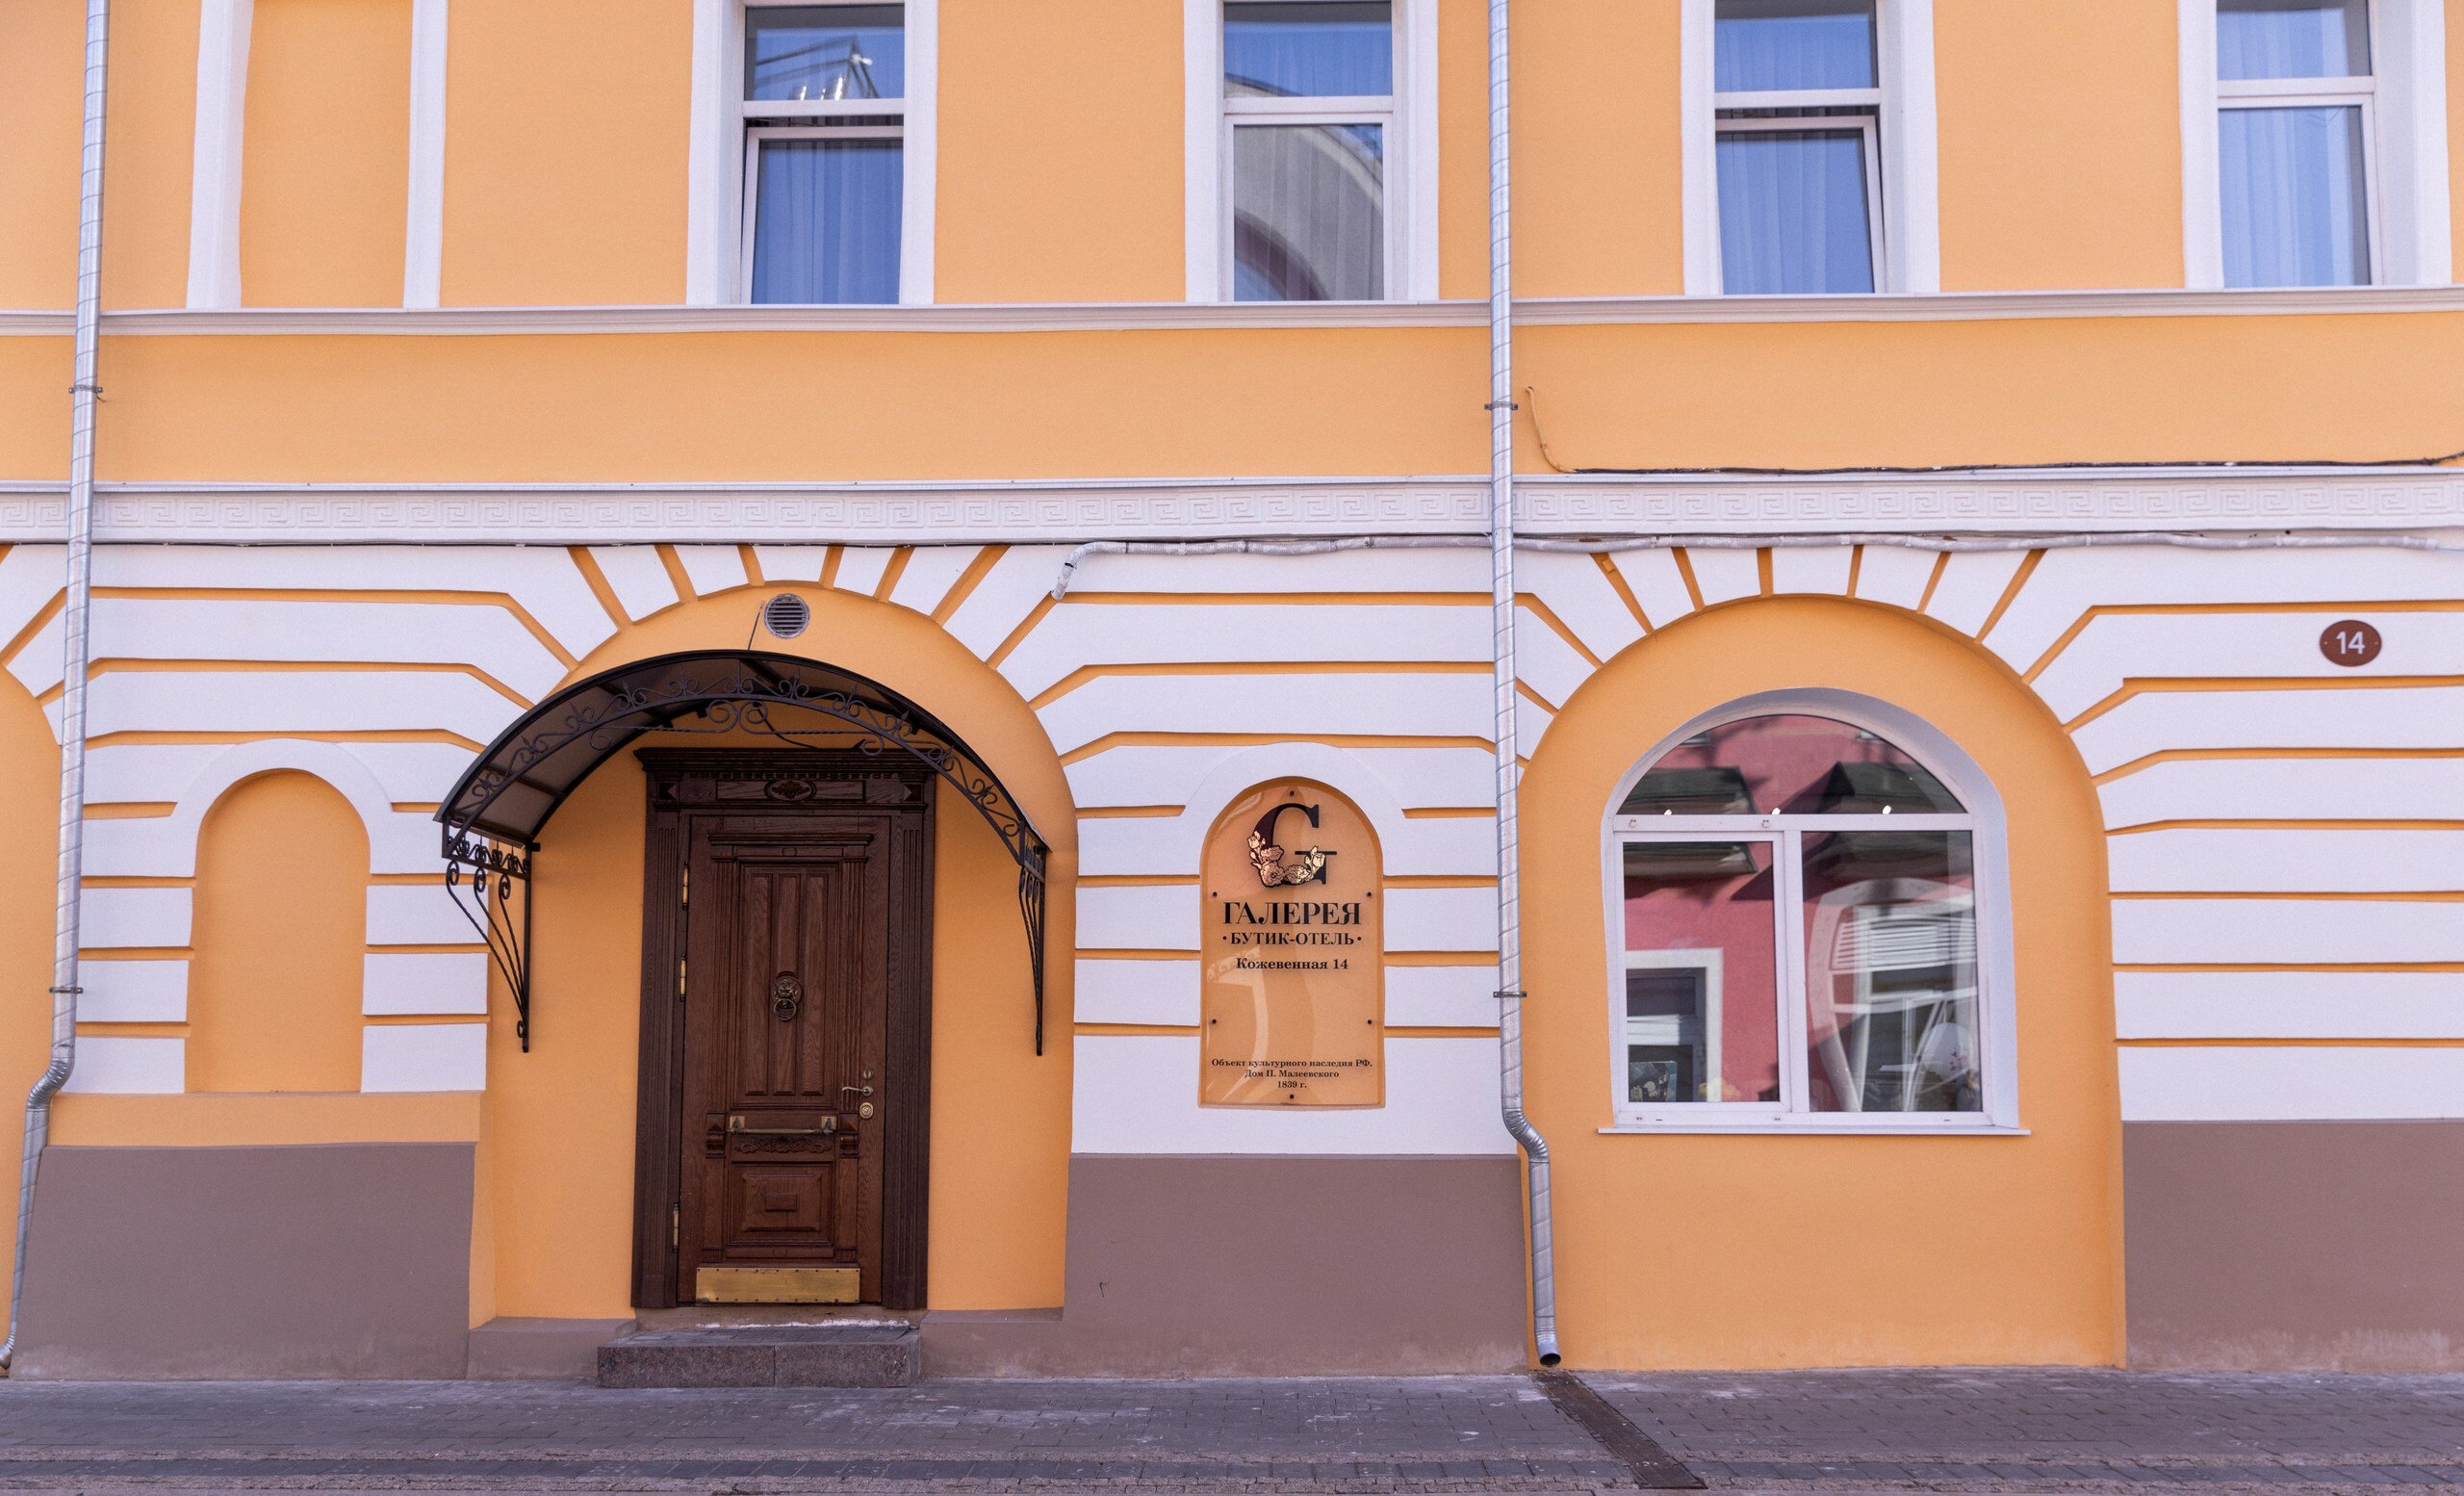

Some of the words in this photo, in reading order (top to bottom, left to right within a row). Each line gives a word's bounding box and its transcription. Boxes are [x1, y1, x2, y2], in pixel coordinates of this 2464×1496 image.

[2335, 631, 2366, 655] 14
[1222, 901, 1361, 925] ГАЛЕРЕЯ
[1236, 957, 1327, 969] Кожевенная
[1333, 957, 1348, 969] 14
[1211, 1058, 1246, 1068] Объект
[1248, 1060, 1307, 1069] культурного
[1355, 1058, 1373, 1068] РФ.
[1245, 1070, 1264, 1078] Дом
[1266, 1070, 1276, 1078] П.
[1278, 1070, 1340, 1079] Малеевского
